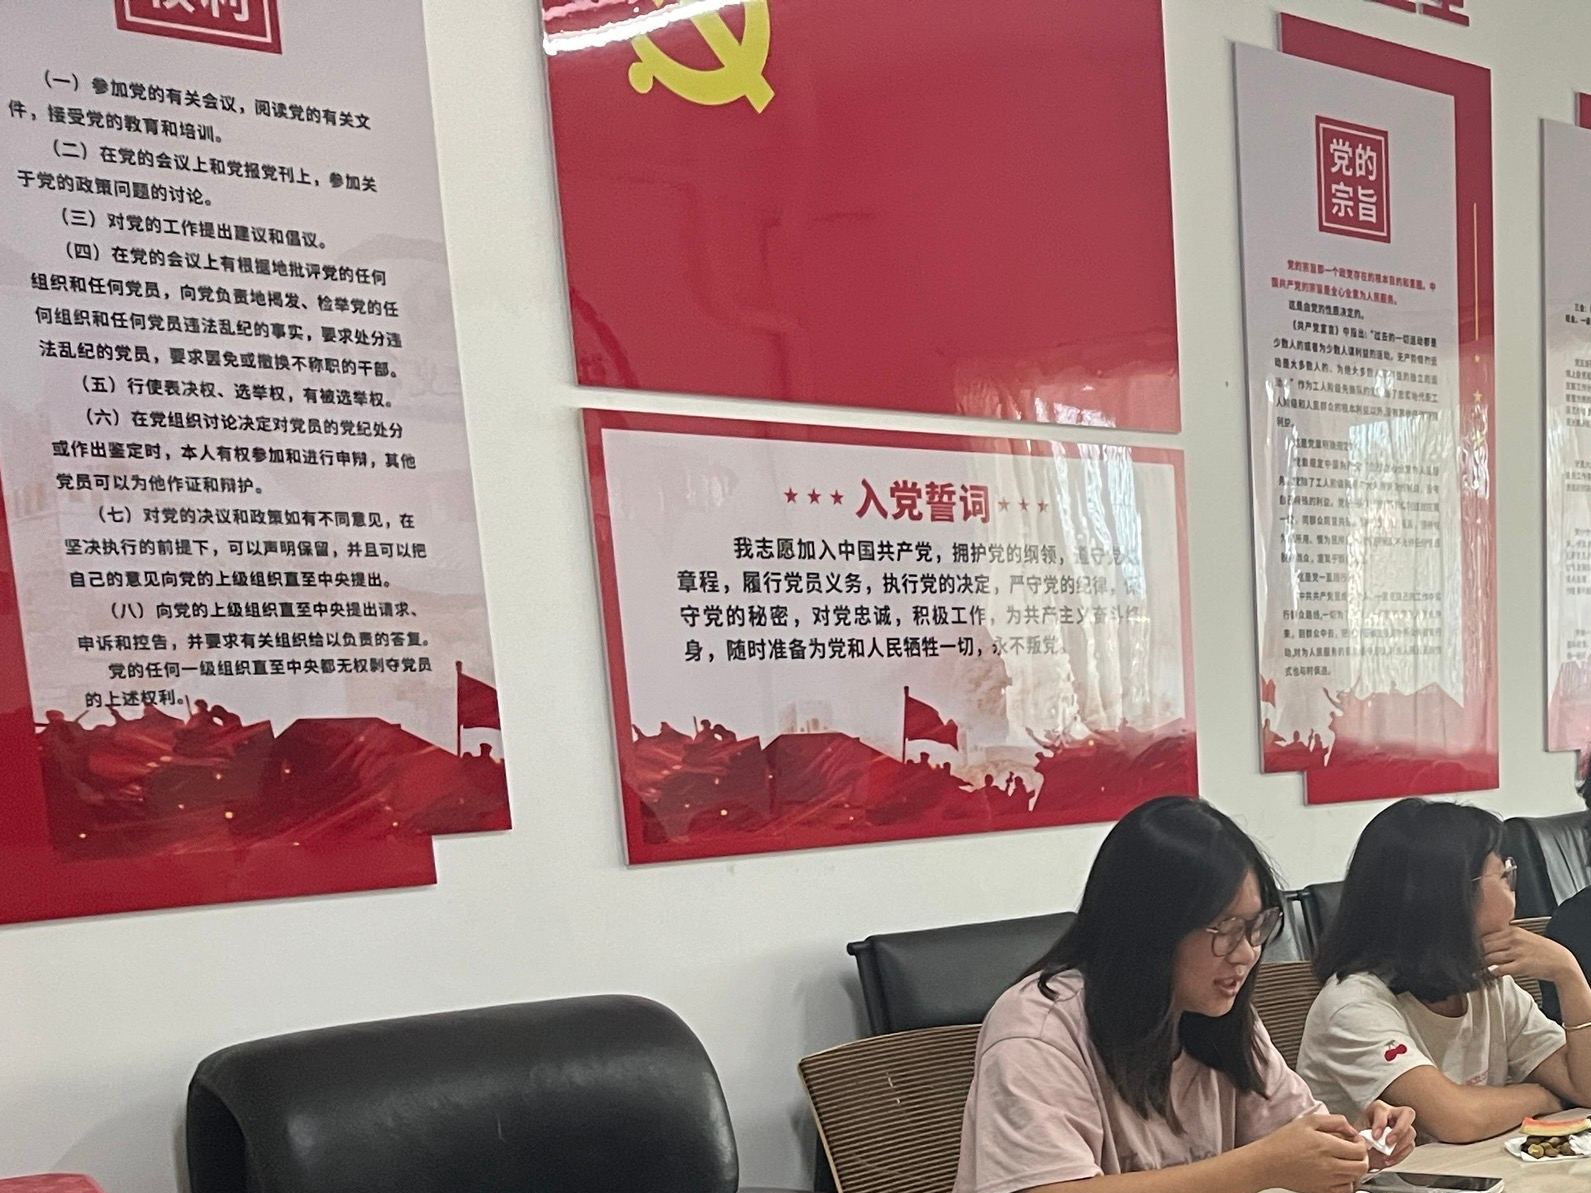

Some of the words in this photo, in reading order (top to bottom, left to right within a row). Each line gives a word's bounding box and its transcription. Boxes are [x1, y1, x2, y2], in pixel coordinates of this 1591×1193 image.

[1329, 138, 1377, 181] 党的
[1331, 181, 1377, 224] 宗旨
[855, 478, 991, 524] 入党誓词
[70, 570, 390, 588] 自己的意见向党的上级组织直至中央提出。
[85, 690, 183, 708] 的上述权利。
